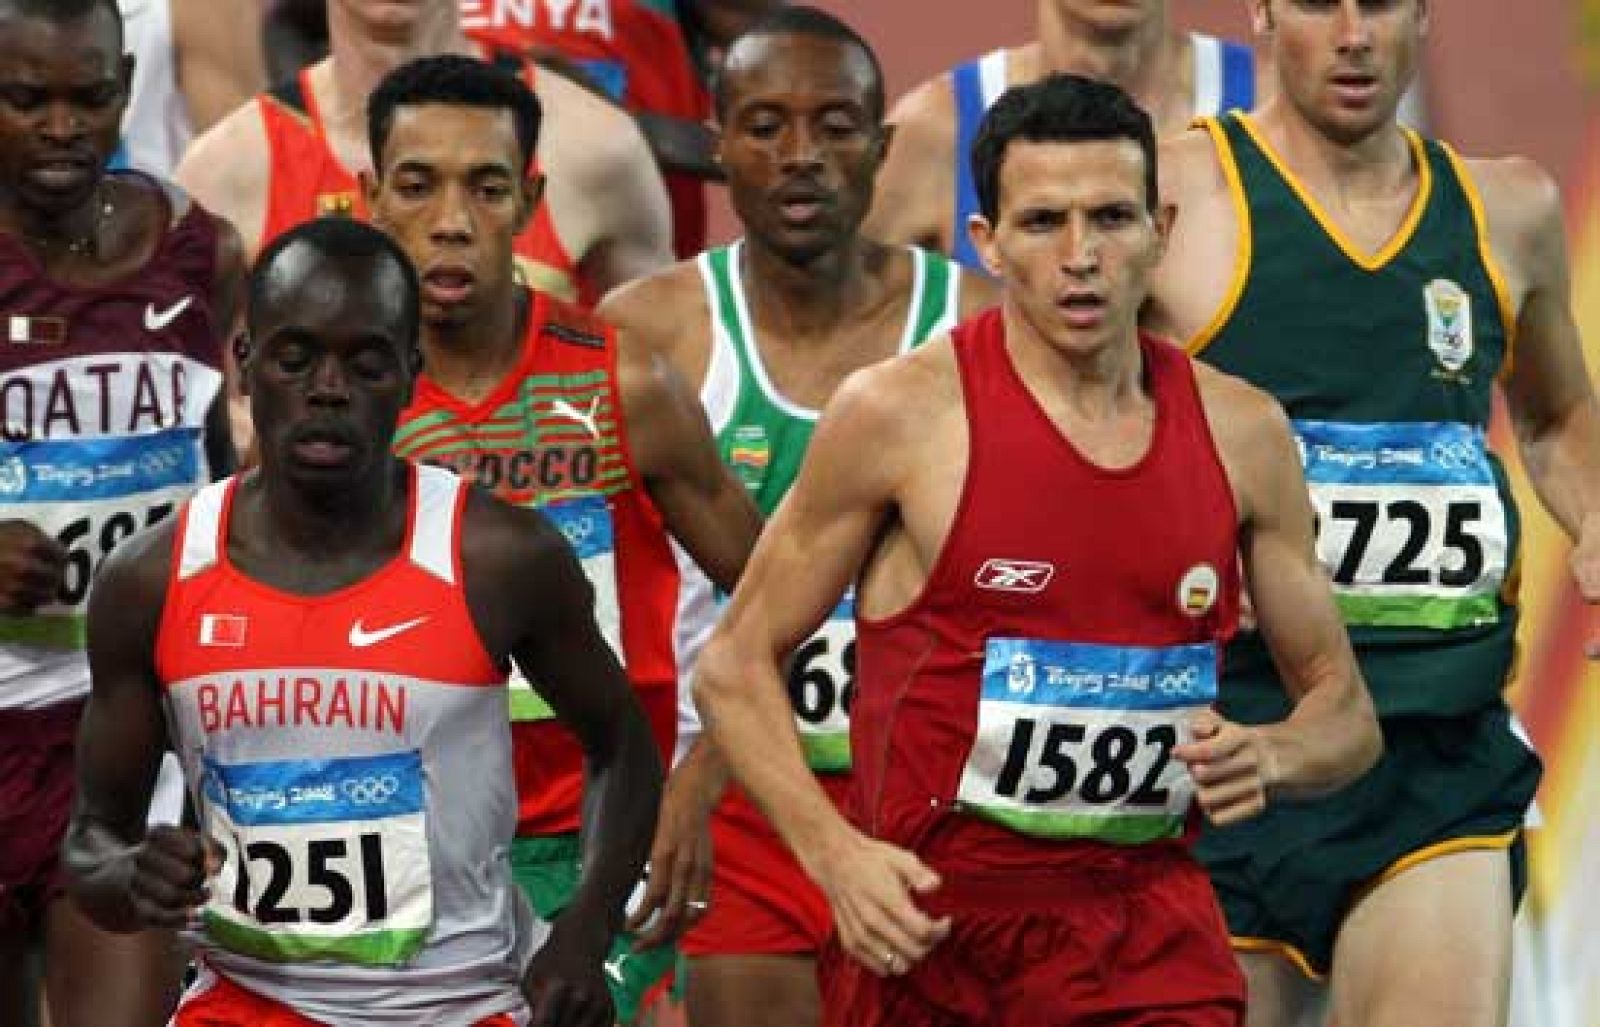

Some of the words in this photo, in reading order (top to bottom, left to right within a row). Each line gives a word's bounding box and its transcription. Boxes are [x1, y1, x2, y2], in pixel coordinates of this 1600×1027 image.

[1312, 501, 1485, 588] 725
[198, 677, 406, 736] BAHRAIN
[995, 718, 1175, 806] 1582
[233, 830, 388, 923] 1251
